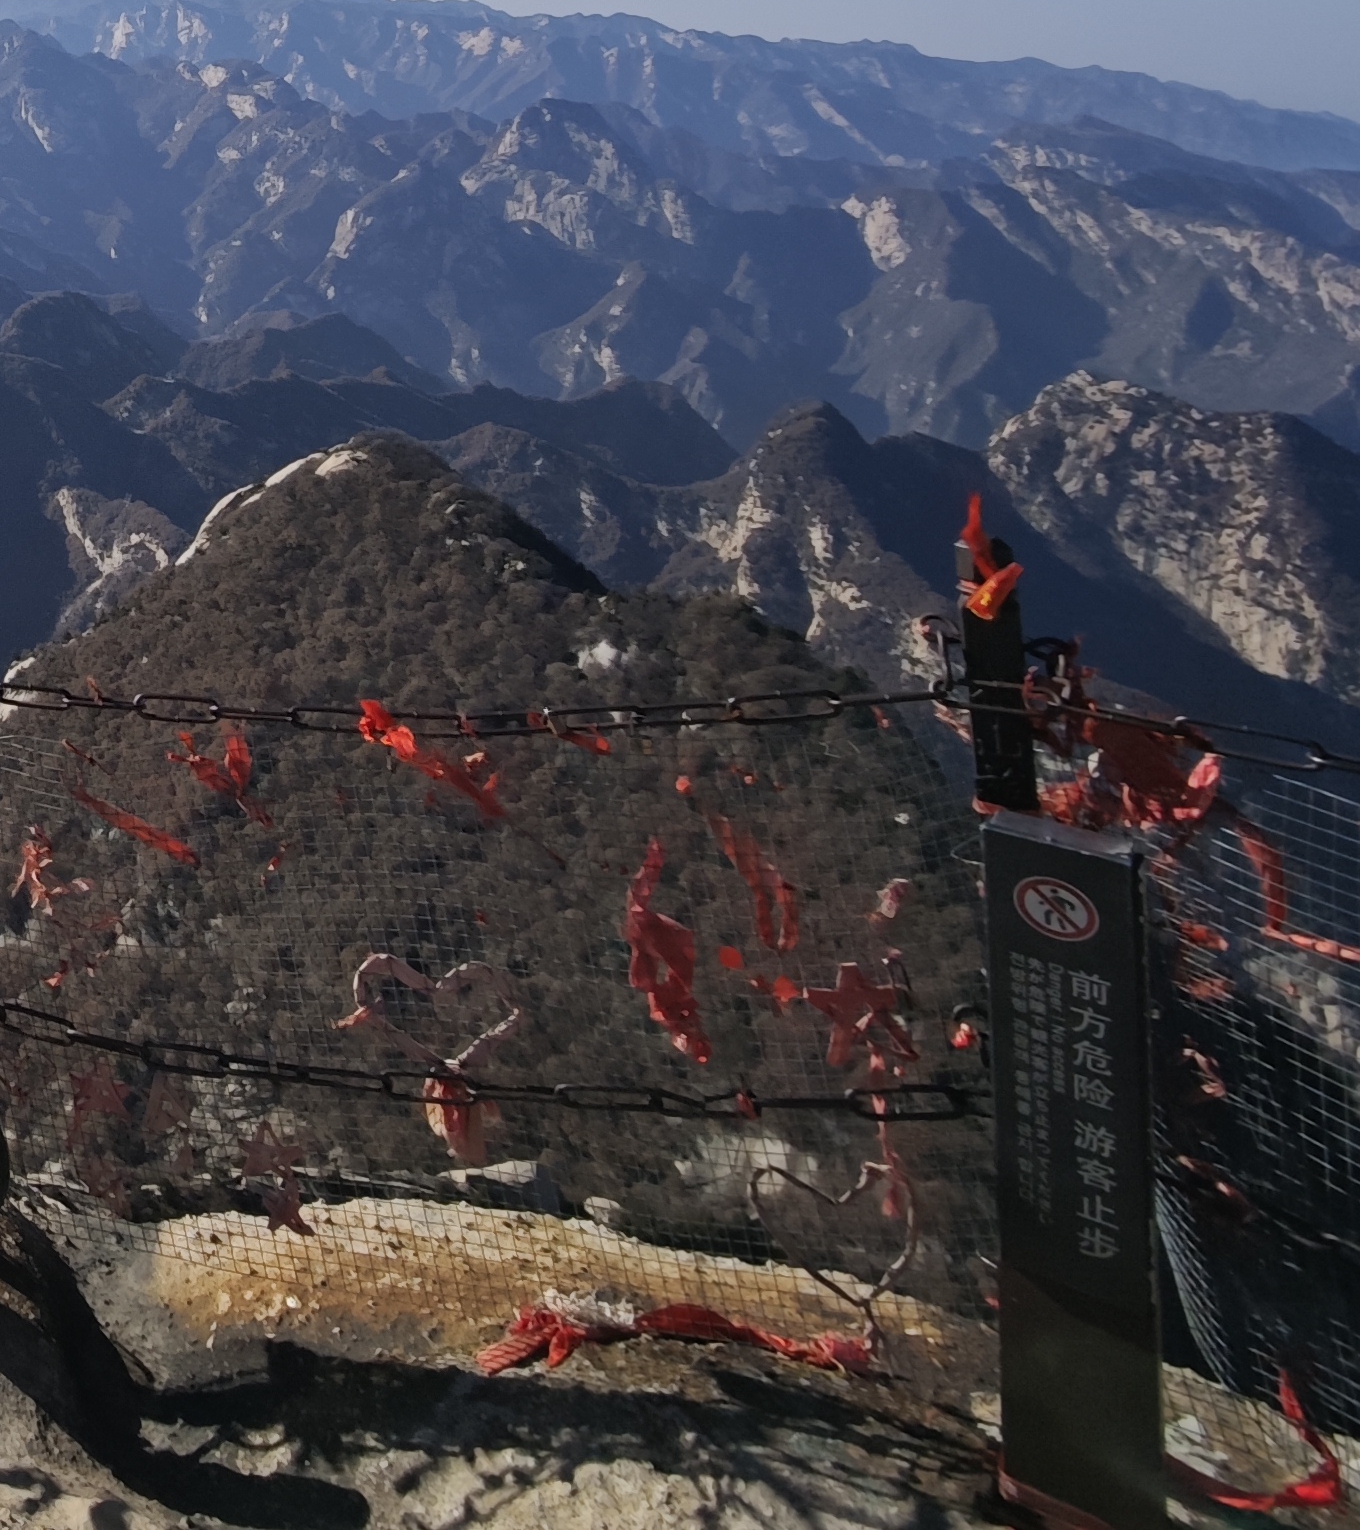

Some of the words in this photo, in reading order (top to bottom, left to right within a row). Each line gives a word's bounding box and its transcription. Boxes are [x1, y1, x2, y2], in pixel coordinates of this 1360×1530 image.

[1047, 962, 1064, 1013] Danger
[1051, 1024, 1067, 1044] No
[1067, 969, 1115, 1112] 前方危险
[1052, 1046, 1067, 1094] access
[1074, 1119, 1121, 1259] 游客止步
